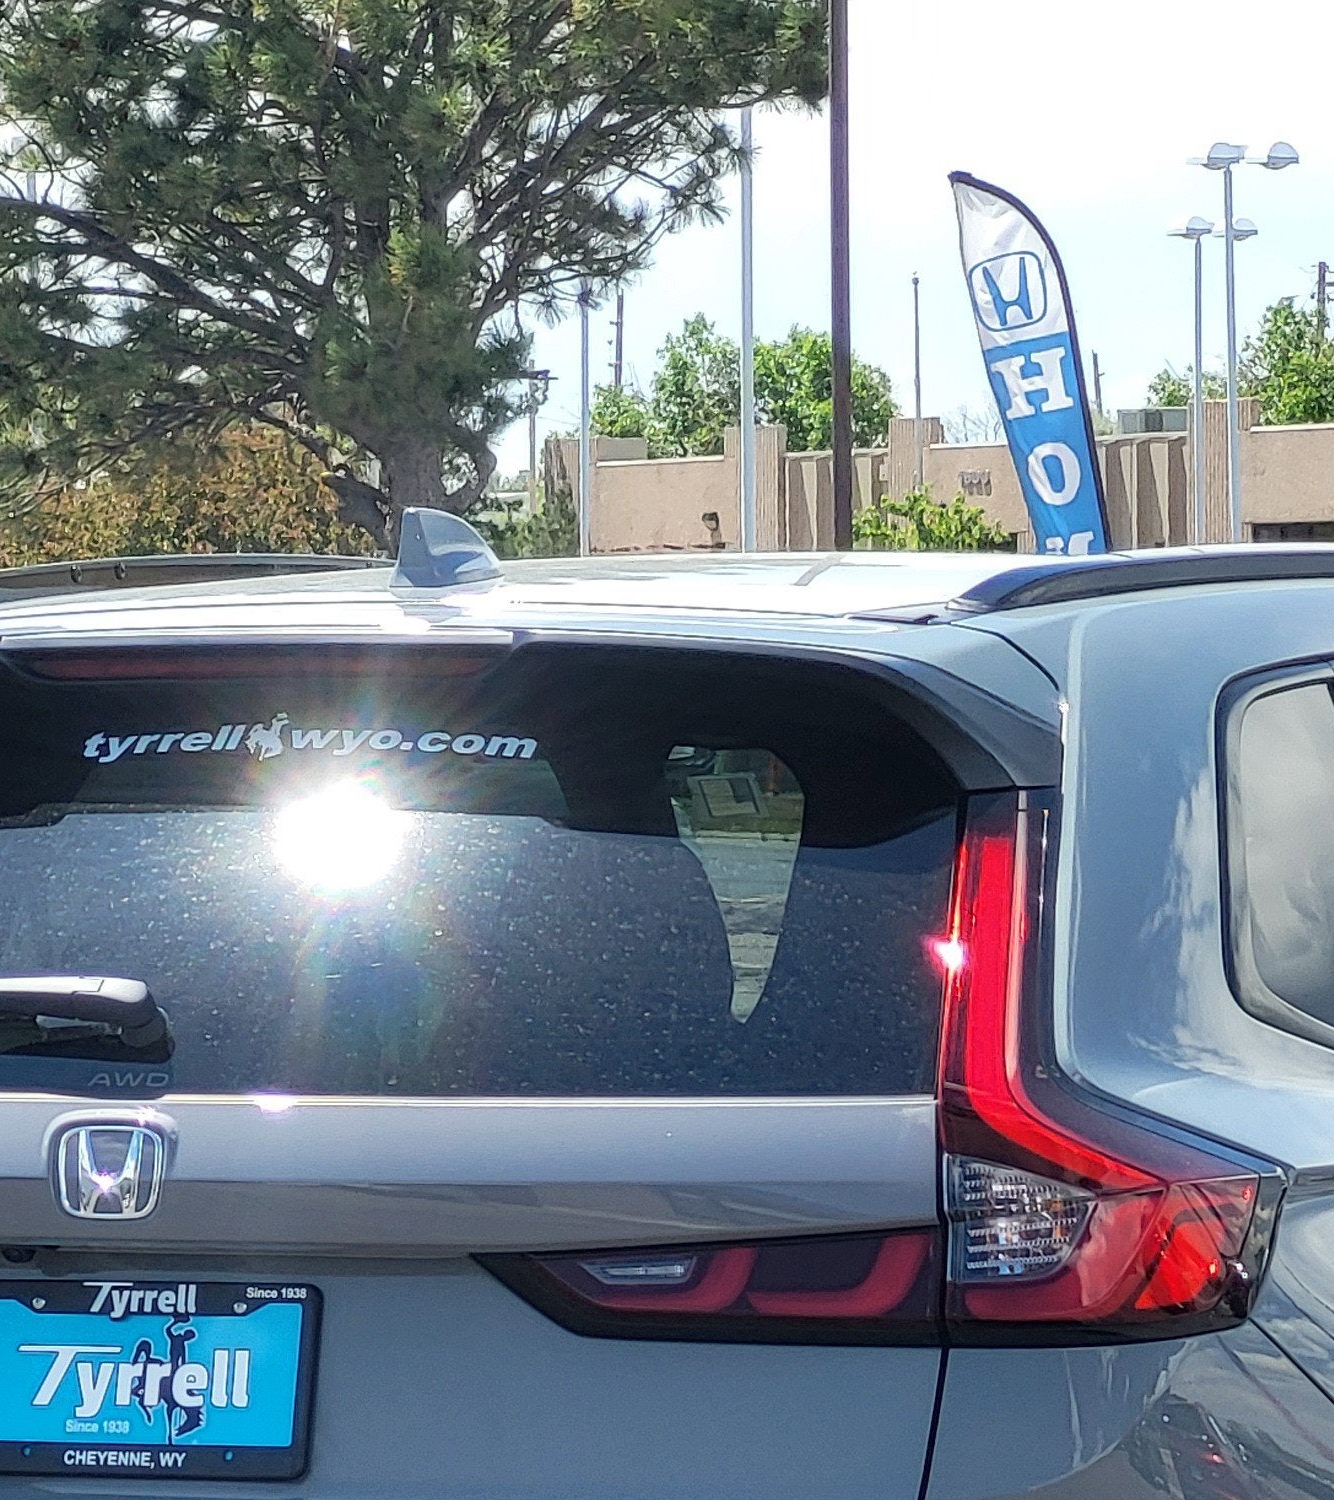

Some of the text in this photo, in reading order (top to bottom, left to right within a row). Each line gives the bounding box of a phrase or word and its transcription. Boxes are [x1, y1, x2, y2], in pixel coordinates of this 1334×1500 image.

[88, 1072, 169, 1087] AWD
[83, 1281, 197, 1318] Tyrrell
[246, 1286, 307, 1299] Since 1938
[17, 1345, 250, 1417] Tyrrell
[66, 1419, 130, 1434] Since 1938
[64, 1450, 186, 1469] CHEYENNE, WY
